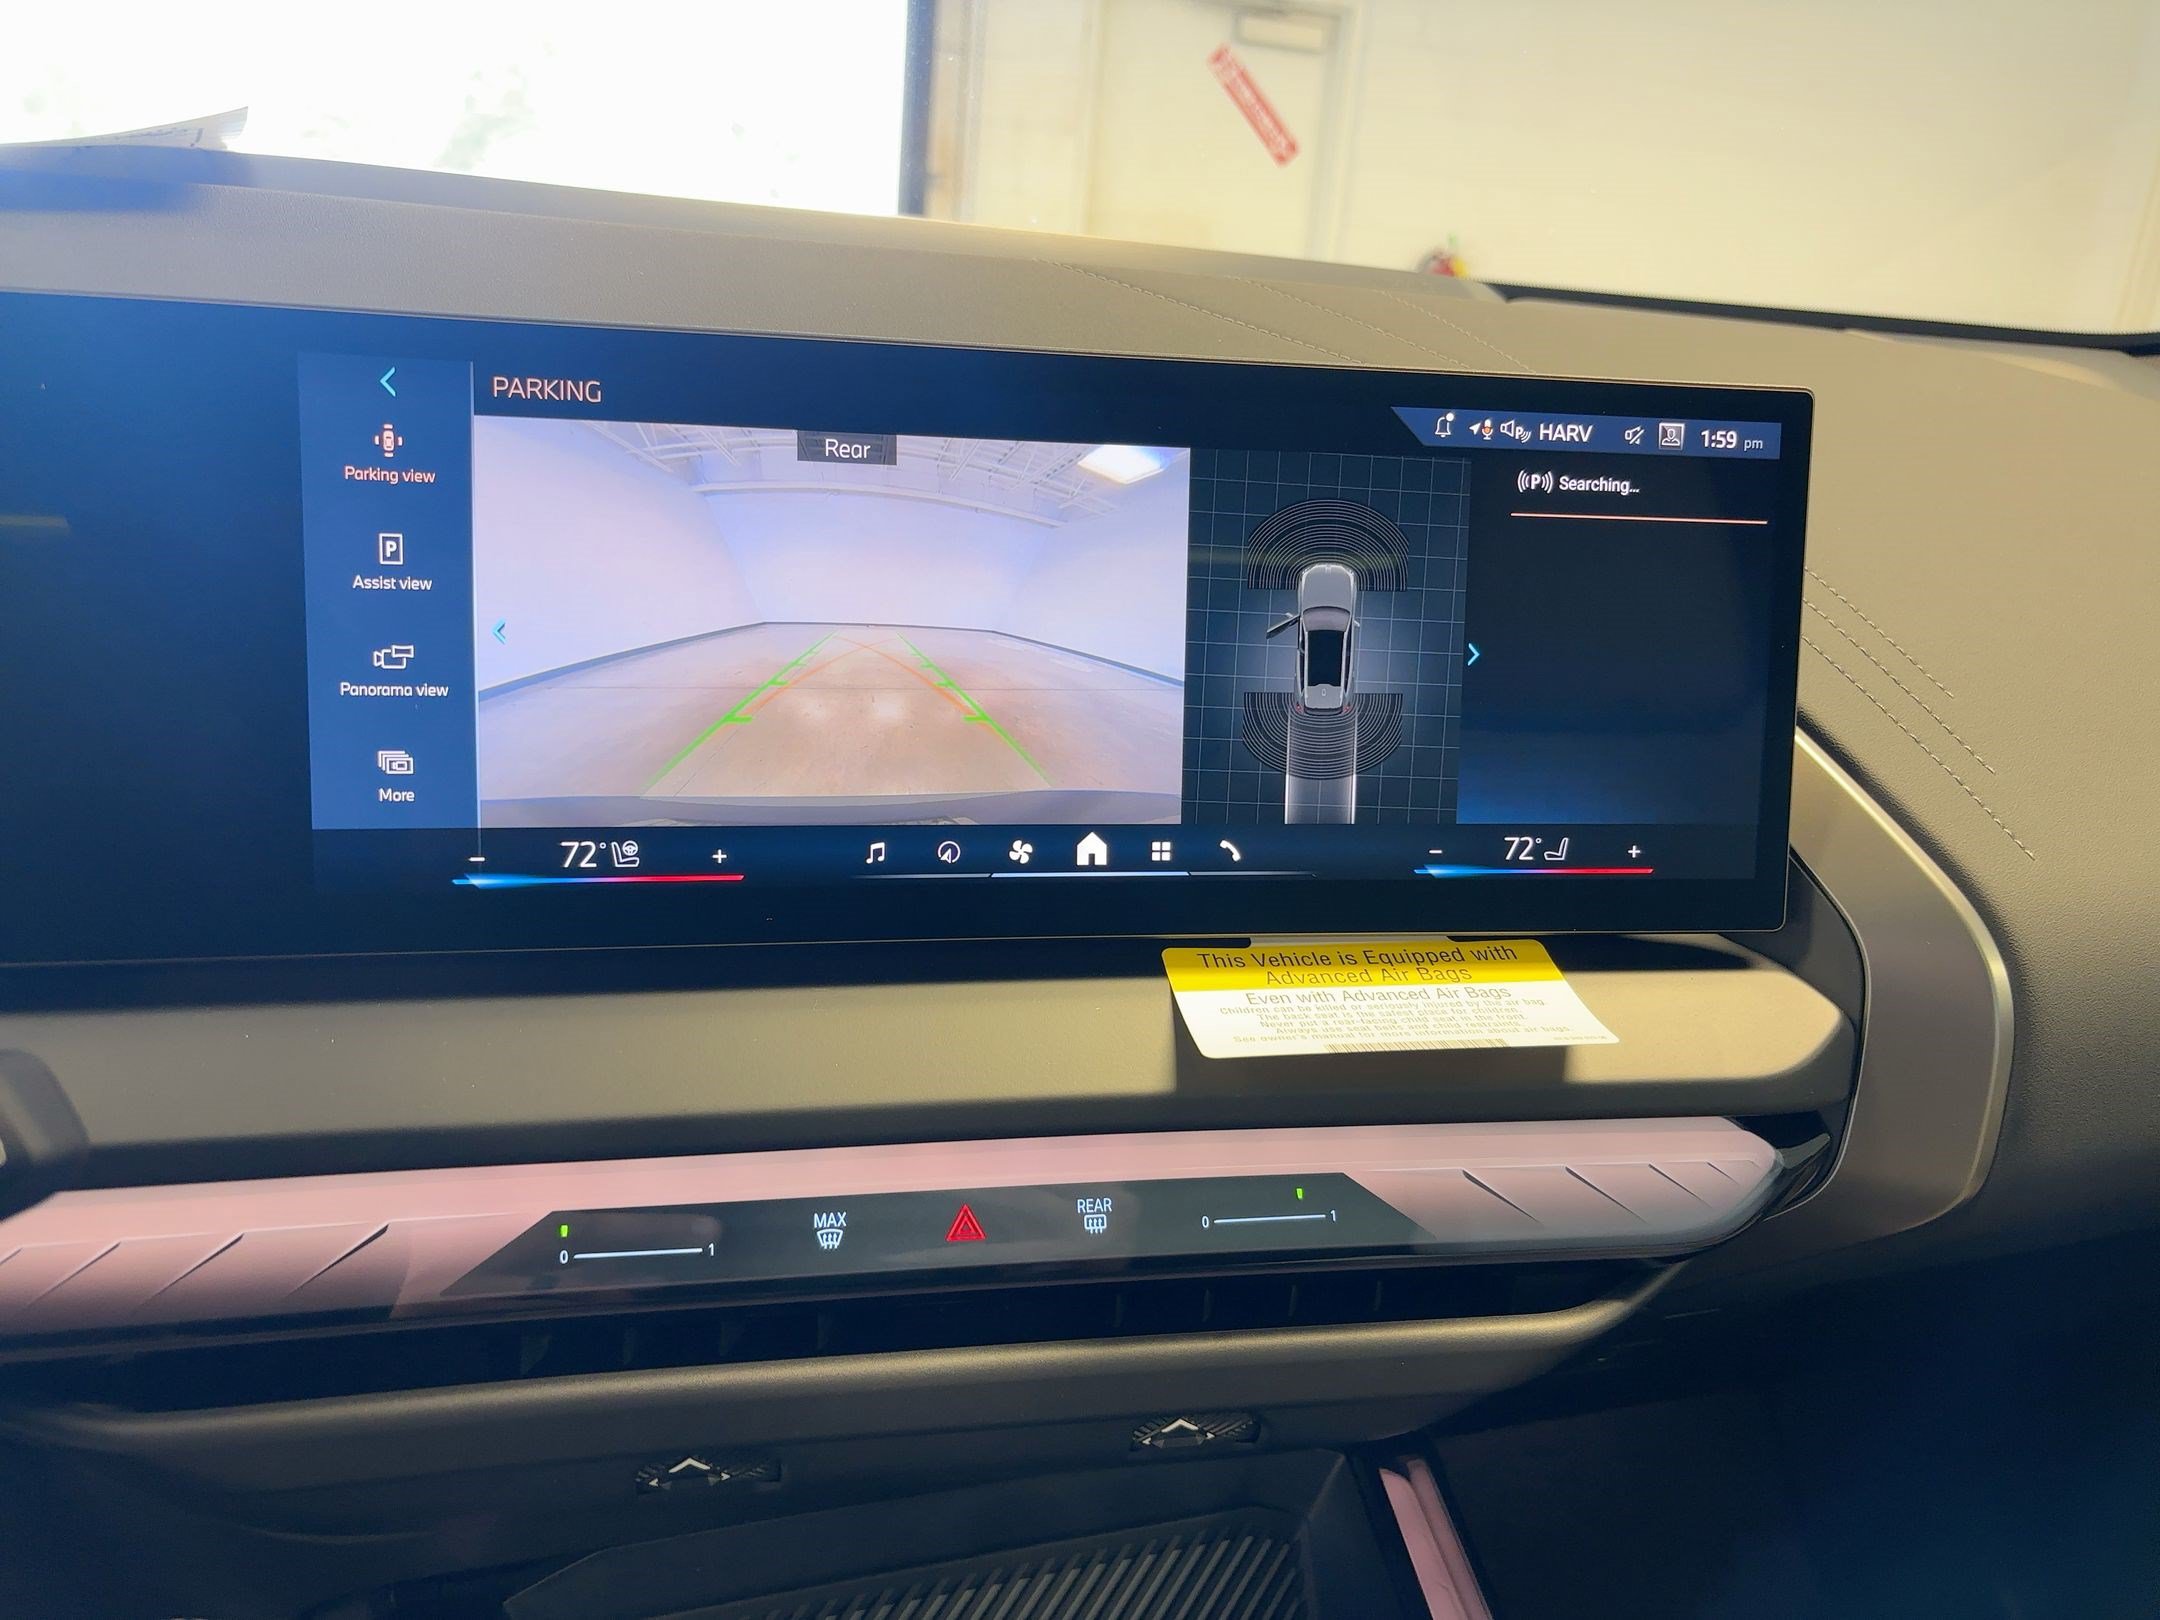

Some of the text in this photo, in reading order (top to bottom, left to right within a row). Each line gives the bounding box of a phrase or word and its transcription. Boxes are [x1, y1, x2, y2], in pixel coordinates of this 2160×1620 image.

[492, 375, 602, 403] PARKING
[1539, 423, 1594, 443] HARV
[1700, 429, 1764, 452] 1:59 pm
[825, 438, 871, 459] Rear
[344, 466, 436, 485] Parking view
[352, 575, 433, 591] Assist view
[340, 682, 449, 698] Panorama view
[378, 788, 415, 803] More
[560, 841, 607, 869] 72°
[1504, 837, 1542, 861] 72°
[1197, 945, 1518, 968] This Vehicle is Equipped with
[1266, 966, 1473, 985] Advanced Air Bags
[1245, 986, 1511, 1005] Even with Advanced Air Bags
[1219, 1006, 1270, 1015] Children
[1367, 1001, 1419, 1010] seriously
[1423, 1000, 1463, 1009] injured
[1465, 1000, 1479, 1010] by
[1483, 999, 1502, 1007] the
[1505, 998, 1520, 1006] air
[1257, 1013, 1280, 1021] The
[1417, 1009, 1448, 1017] place
[1259, 1020, 1294, 1028] Never
[1299, 1019, 1318, 1027] put
[1401, 1016, 1429, 1024] child
[1076, 1197, 1113, 1214] REAR
[813, 1211, 848, 1229] MAX
[1201, 1209, 1337, 1229] 0 1
[559, 1243, 716, 1265] 0 1
